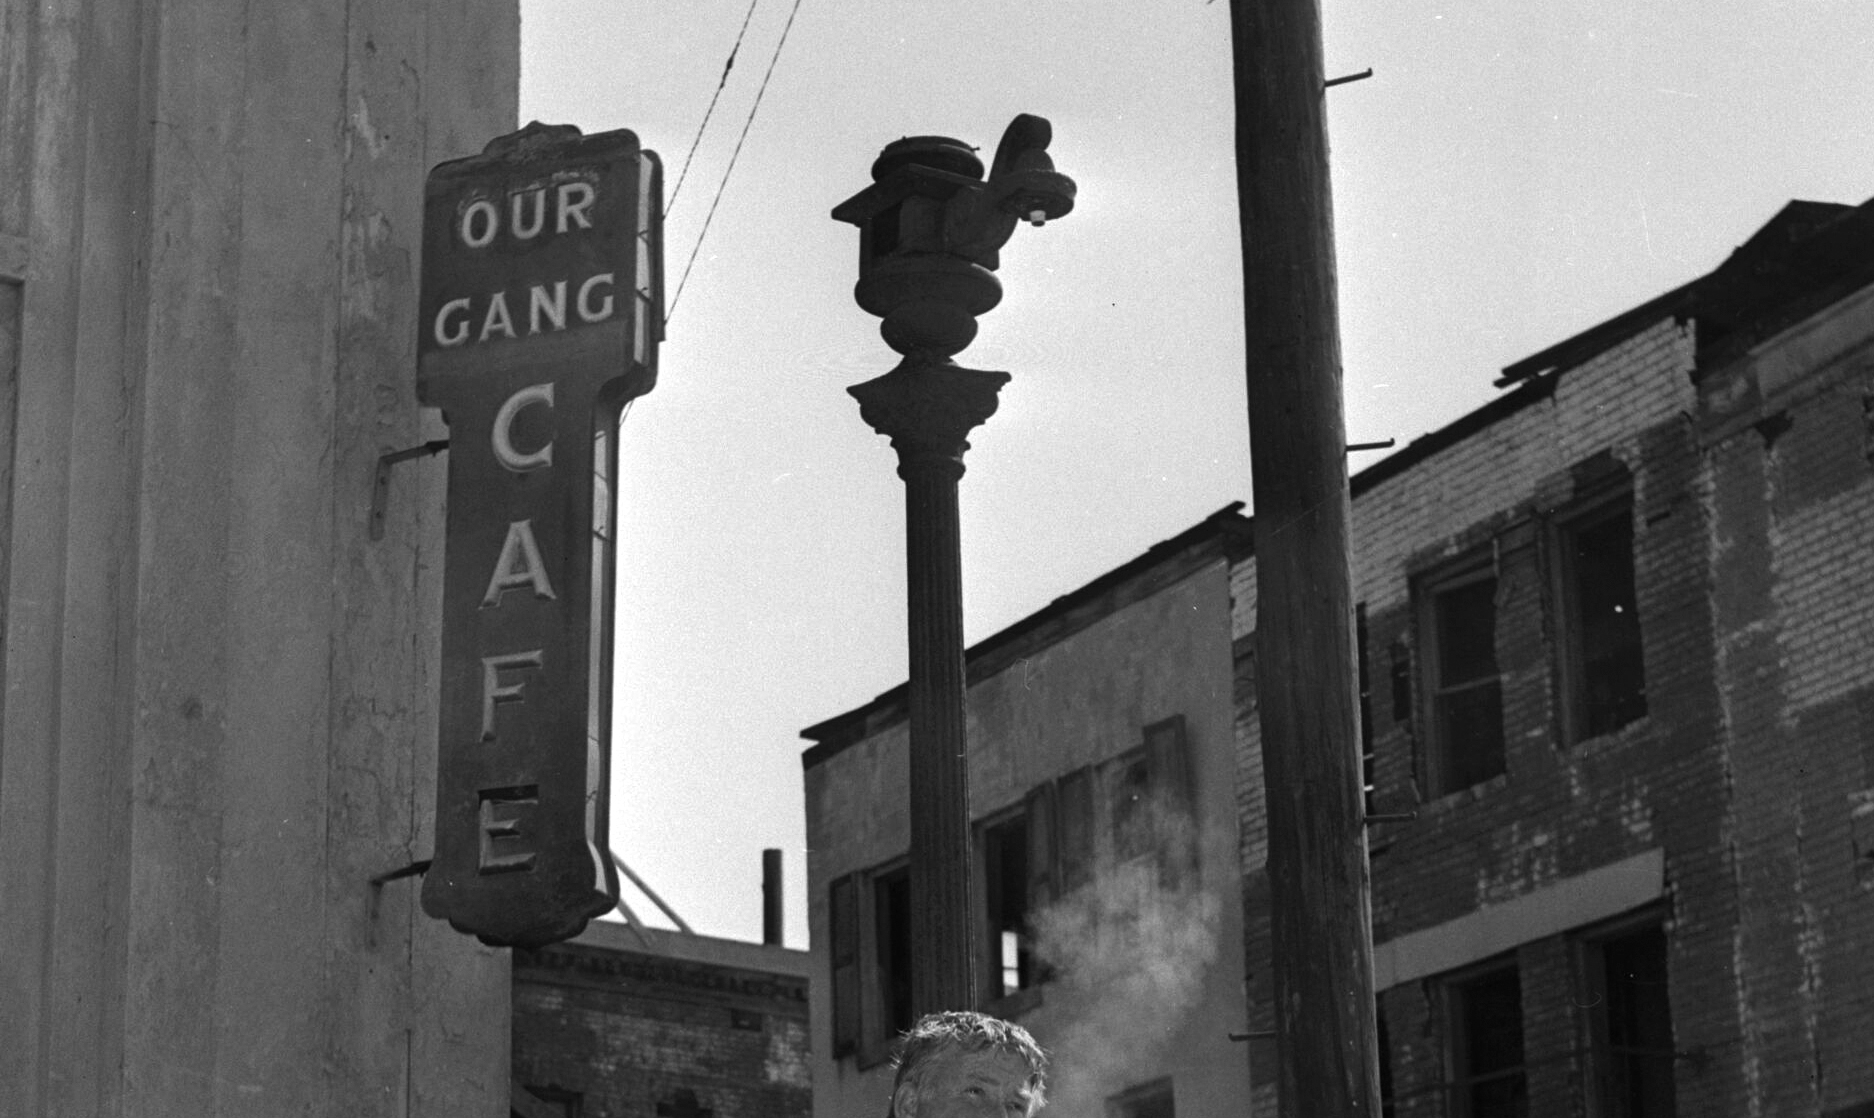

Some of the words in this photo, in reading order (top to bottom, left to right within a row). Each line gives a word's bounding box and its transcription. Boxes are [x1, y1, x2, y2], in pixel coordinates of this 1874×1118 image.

[460, 181, 597, 249] OUR
[433, 272, 615, 347] GANG
[478, 382, 558, 876] CAFE
